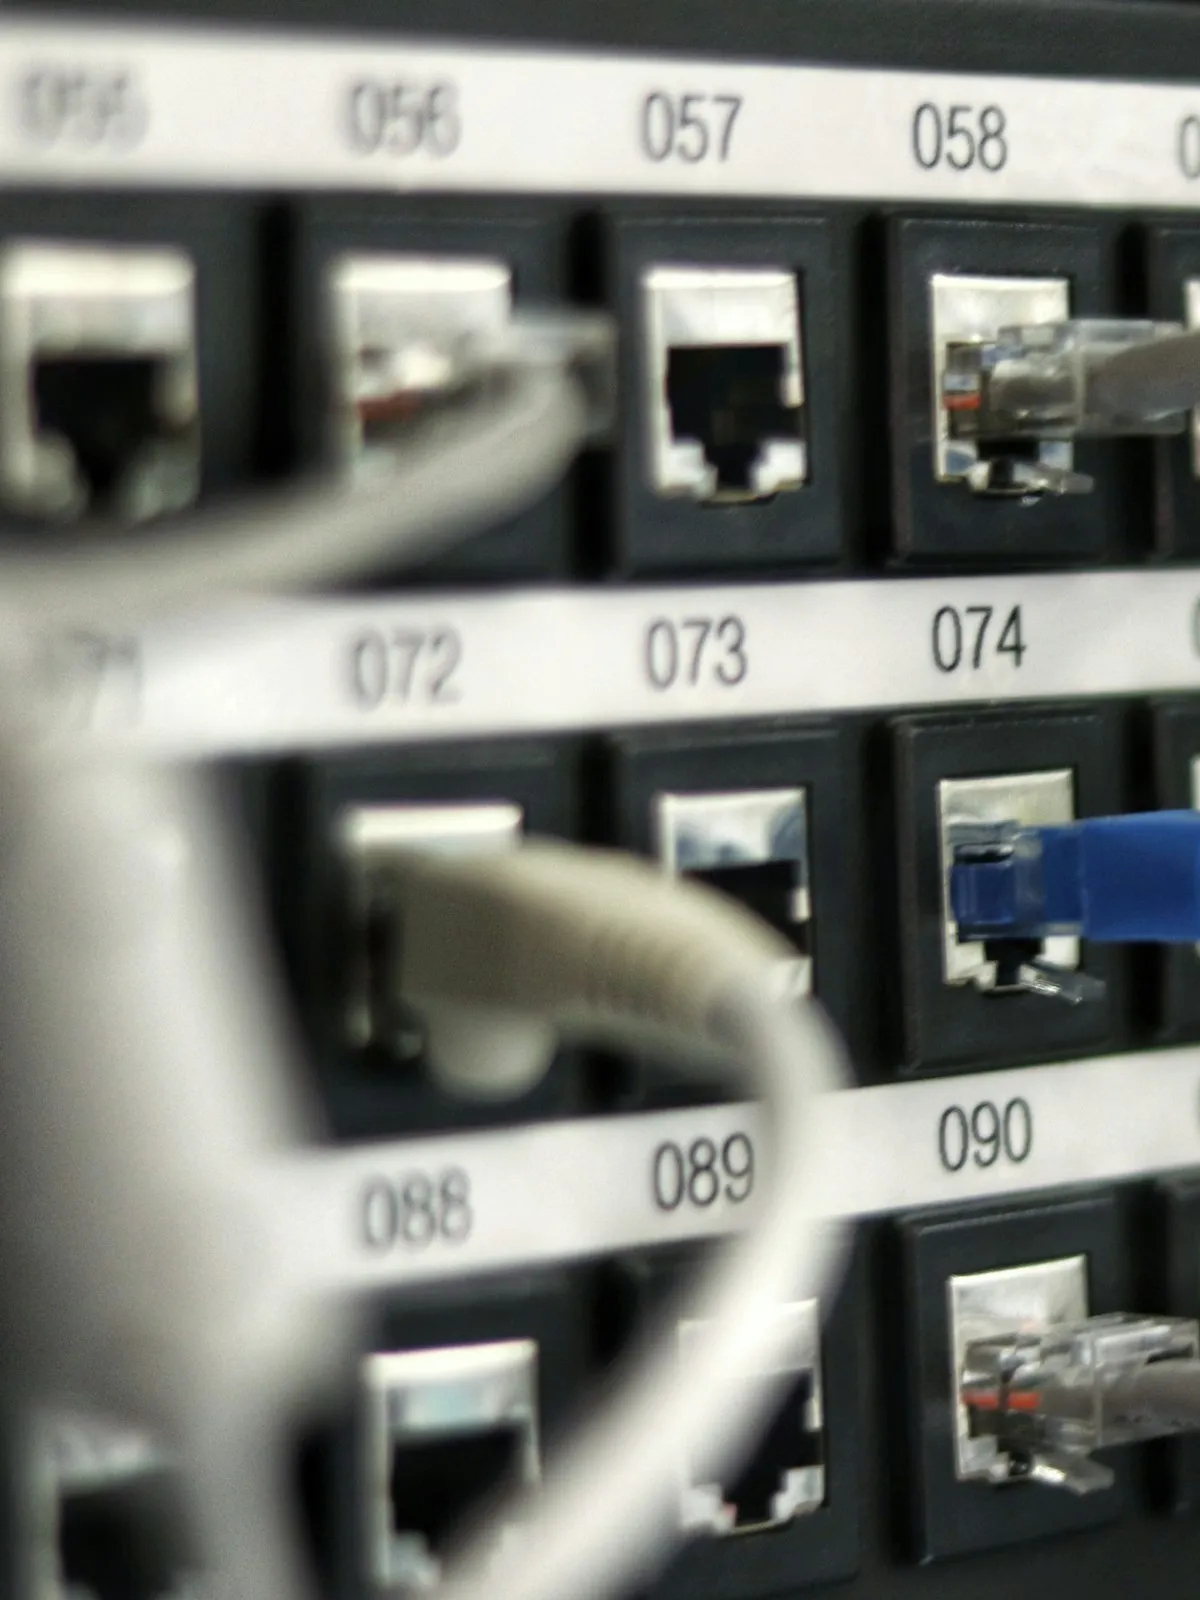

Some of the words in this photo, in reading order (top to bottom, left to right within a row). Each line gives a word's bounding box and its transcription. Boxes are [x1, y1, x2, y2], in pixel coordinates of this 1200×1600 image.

[342, 80, 462, 158] 056
[640, 90, 744, 162] 057
[912, 102, 1007, 172] 058
[350, 624, 464, 712] 072
[646, 614, 747, 692] 073
[932, 603, 1025, 672] 074
[362, 1165, 473, 1248] 088
[652, 1132, 756, 1211] 089
[938, 1097, 1033, 1172] 090
